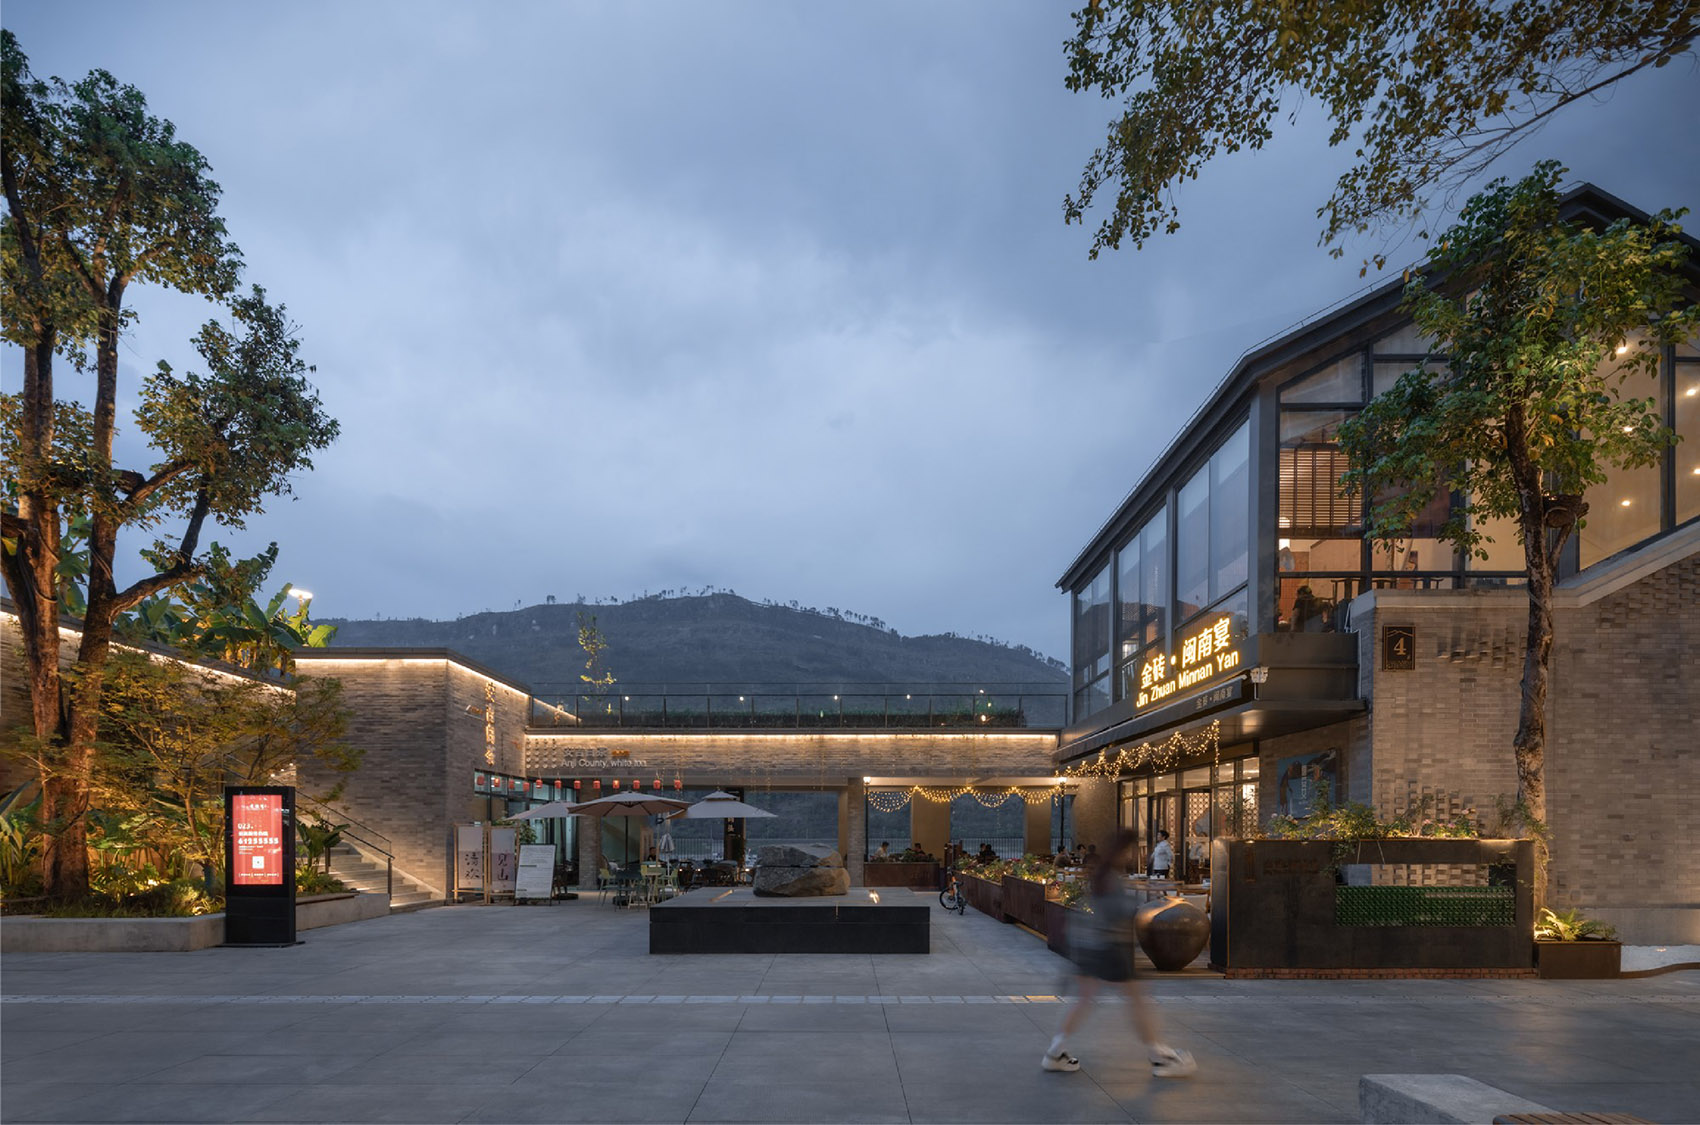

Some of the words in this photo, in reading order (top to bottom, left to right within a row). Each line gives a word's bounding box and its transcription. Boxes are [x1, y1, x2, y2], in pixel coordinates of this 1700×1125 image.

[1393, 637, 1407, 656] 4
[1136, 691, 1149, 708] Jin
[1150, 680, 1176, 702] Zhuan
[1178, 662, 1213, 690] Minnan
[1216, 650, 1239, 673] Yan
[561, 759, 577, 769] Anji
